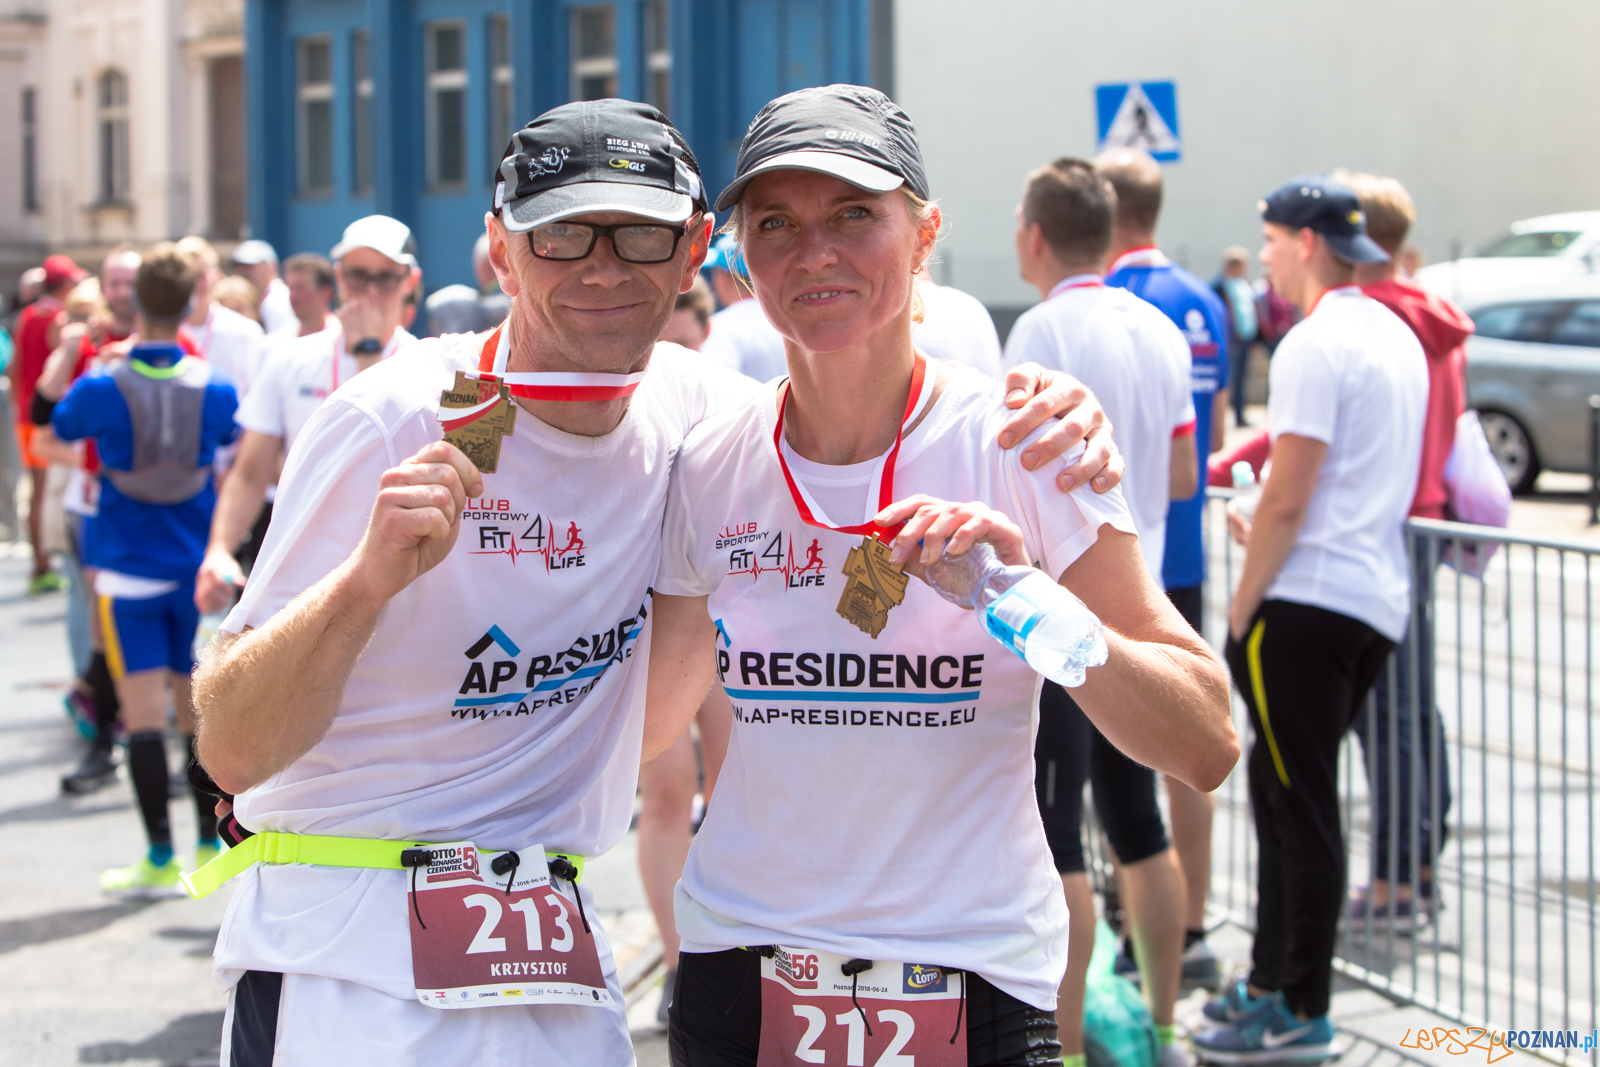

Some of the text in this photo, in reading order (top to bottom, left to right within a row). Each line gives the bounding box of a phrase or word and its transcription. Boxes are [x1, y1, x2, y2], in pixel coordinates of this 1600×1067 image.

[607, 138, 651, 151] BIEG LWA
[840, 131, 881, 148] HI-TEC
[629, 161, 646, 172] GLS
[444, 392, 478, 405] POZNAŃ
[464, 498, 510, 511] LUB
[460, 511, 530, 521] PORTOWY
[520, 513, 546, 548] 4
[715, 531, 770, 550] SPORTOWY
[761, 530, 785, 566] 4
[874, 545, 885, 557] 62
[550, 555, 586, 570] LIFE
[788, 574, 826, 588] LIFE
[715, 648, 985, 689] P RESIDENCE
[458, 661, 518, 695] AP
[430, 848, 457, 860] OTTO
[429, 857, 462, 867] OZNAŃSKI
[426, 864, 463, 875] CZERWIEC
[463, 893, 574, 954] 213
[490, 962, 568, 976] KRZYSZTOF
[915, 971, 938, 984] LOTTO
[857, 985, 888, 993] 2018-06-24
[792, 1004, 916, 1067] 212
